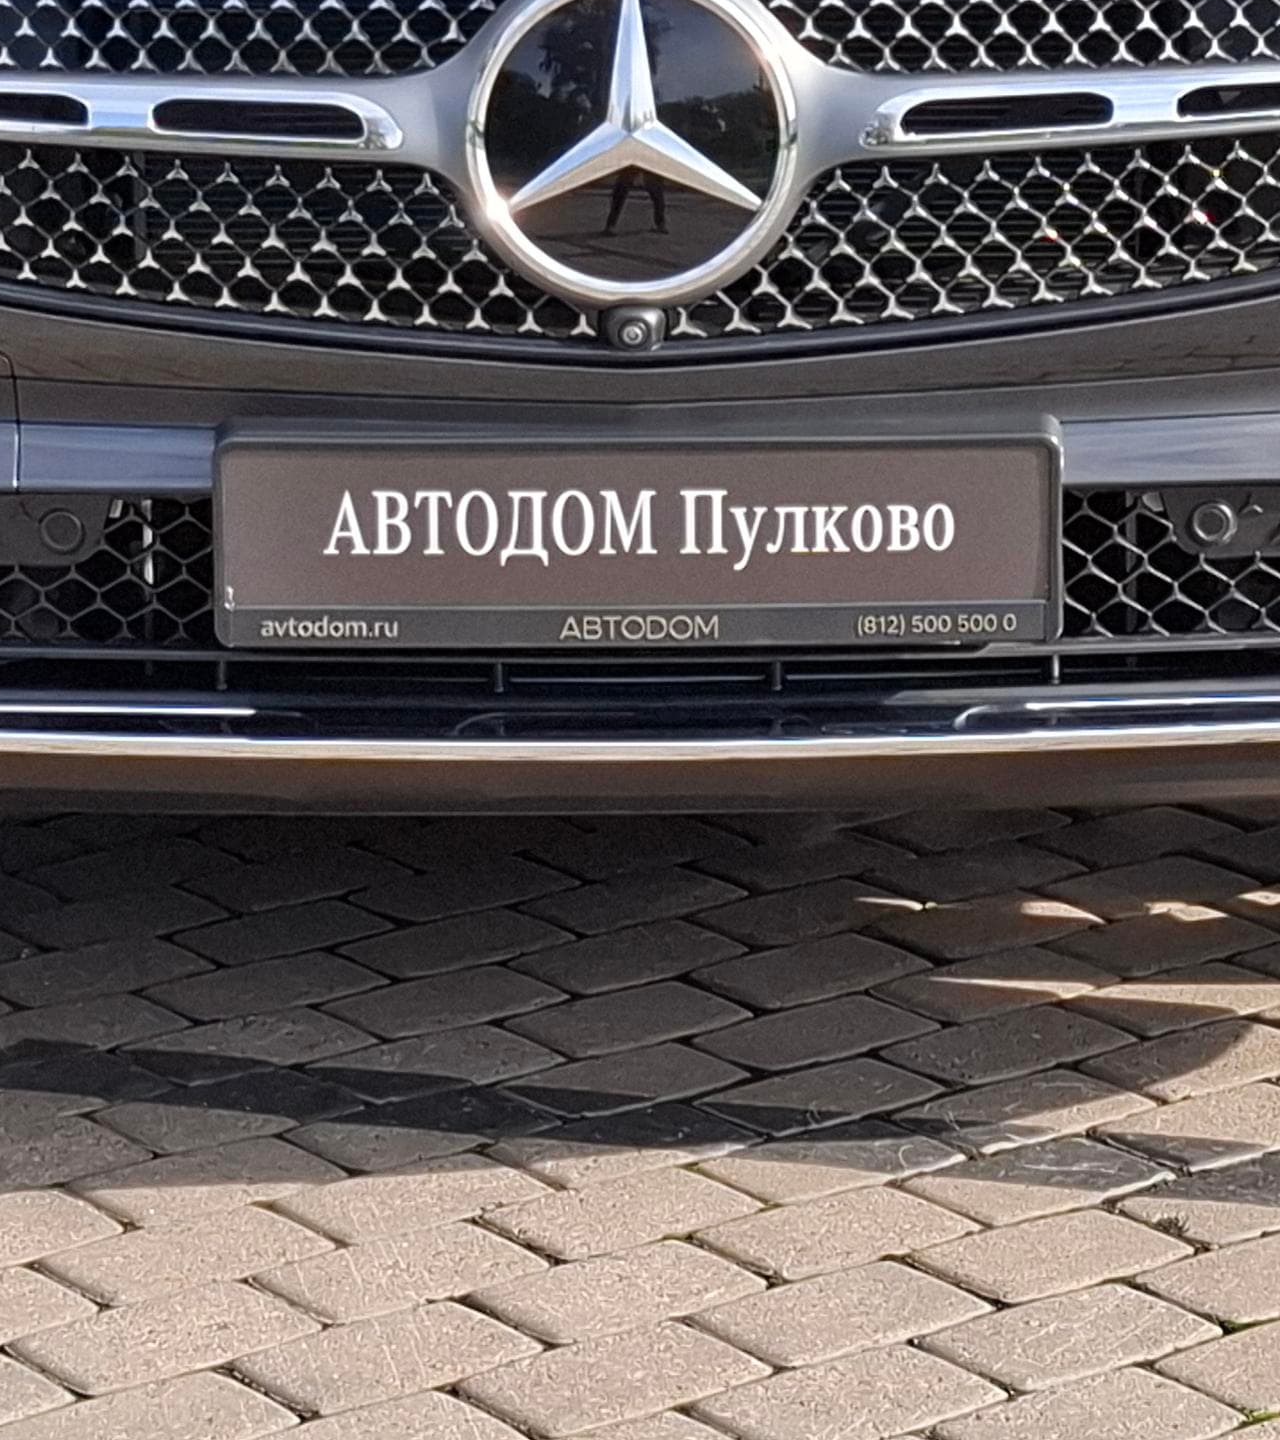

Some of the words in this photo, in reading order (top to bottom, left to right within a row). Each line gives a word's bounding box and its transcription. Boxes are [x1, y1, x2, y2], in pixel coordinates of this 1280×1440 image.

[322, 489, 658, 567] АВТОДОМ
[679, 489, 955, 571] Пулково
[260, 615, 399, 638] avtodom.ru
[856, 613, 906, 637] (812)
[911, 615, 952, 633] 500
[957, 613, 998, 633] 500
[1002, 613, 1017, 631] 0
